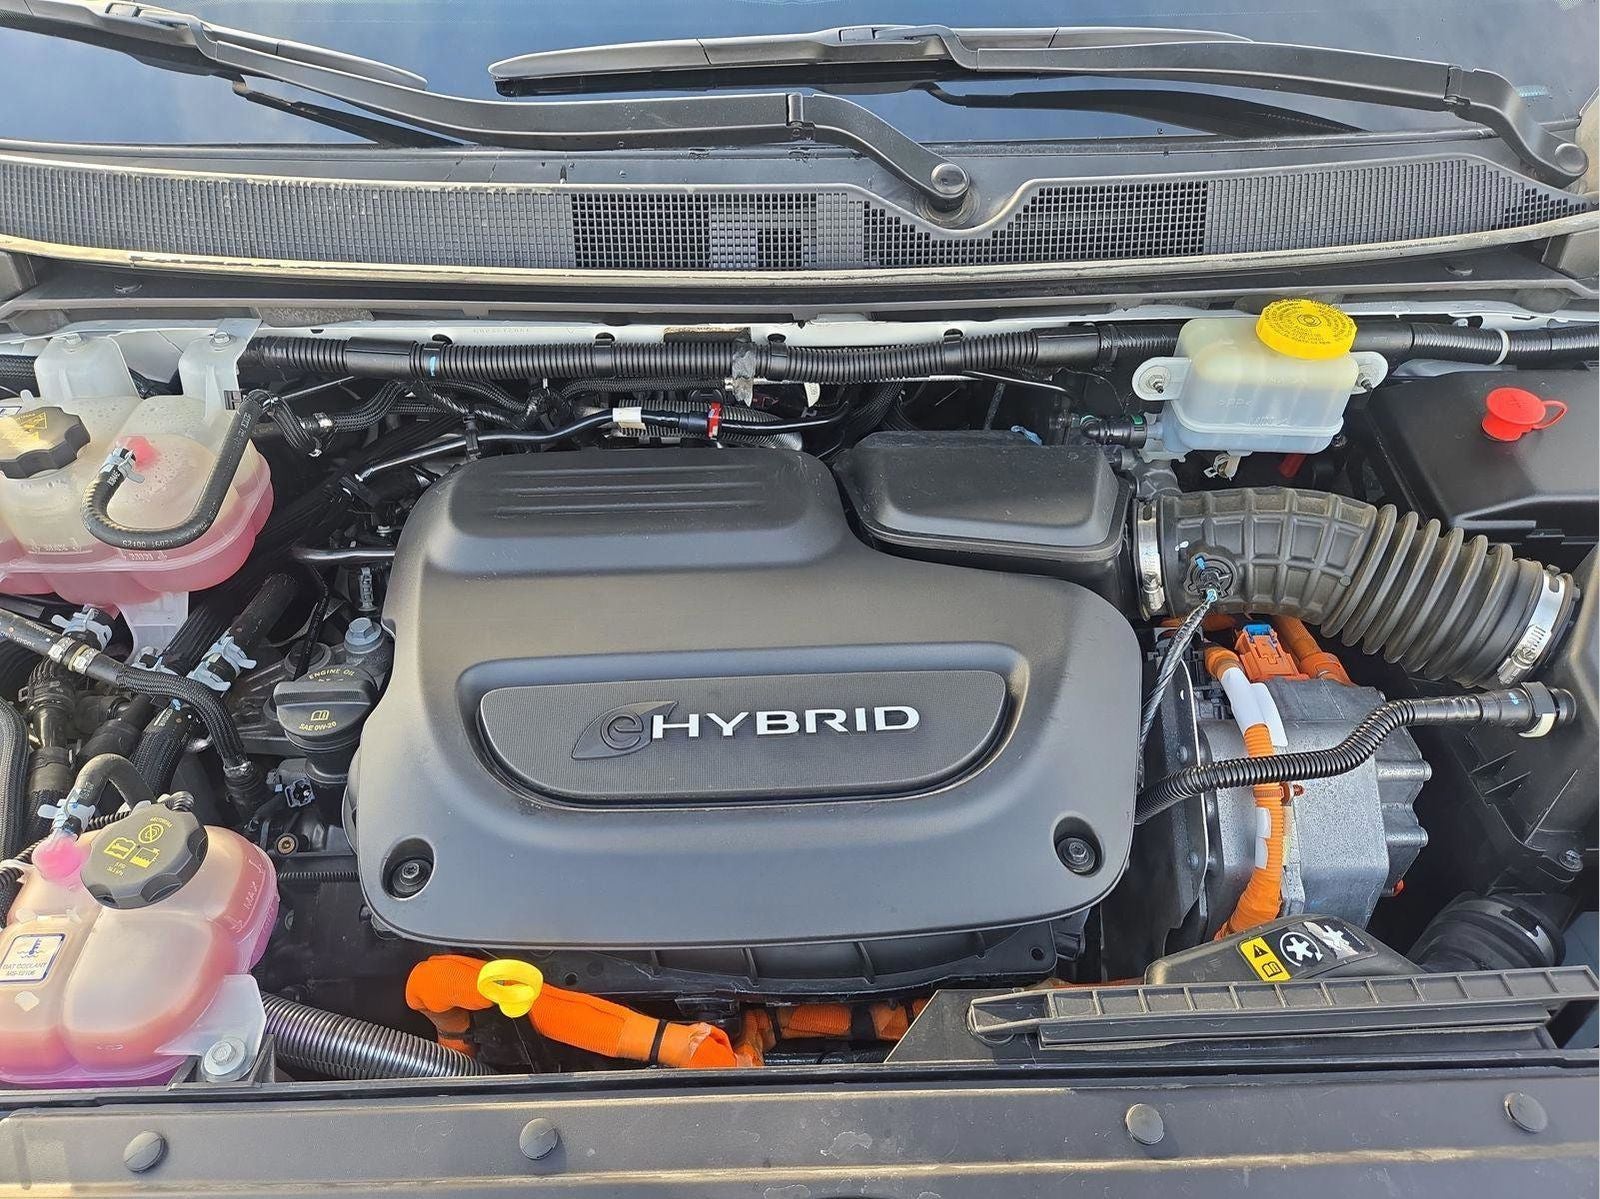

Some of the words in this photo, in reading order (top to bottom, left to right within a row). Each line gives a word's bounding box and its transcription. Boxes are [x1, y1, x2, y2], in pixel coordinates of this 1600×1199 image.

[308, 668, 341, 679] ENGINE
[343, 668, 355, 677] OIL
[298, 723, 314, 731] SAE
